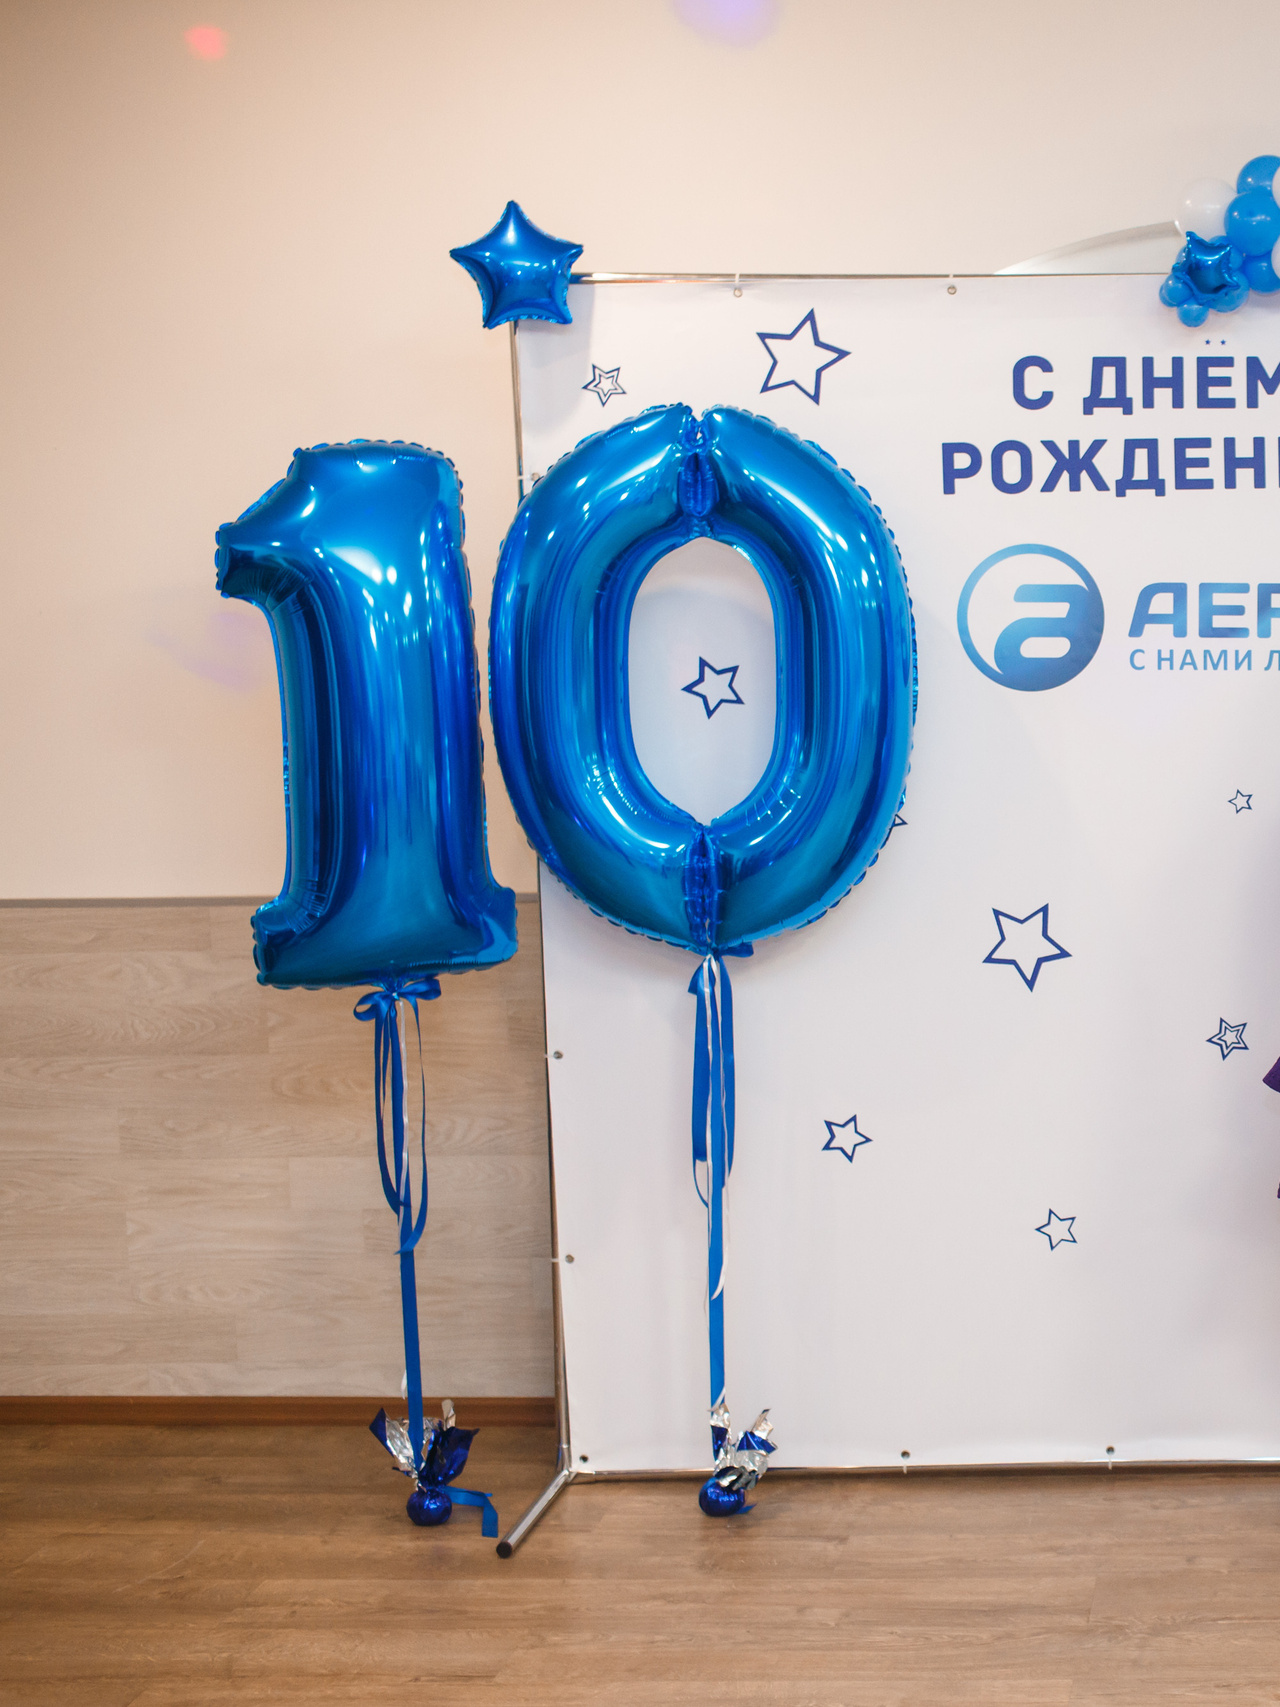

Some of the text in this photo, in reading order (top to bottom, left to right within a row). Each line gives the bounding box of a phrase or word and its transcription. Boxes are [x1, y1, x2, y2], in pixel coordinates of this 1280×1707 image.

[1012, 355, 1054, 411] С
[1129, 648, 1146, 671] С
[1157, 648, 1253, 671] НАМИ
[215, 403, 918, 989] 10
